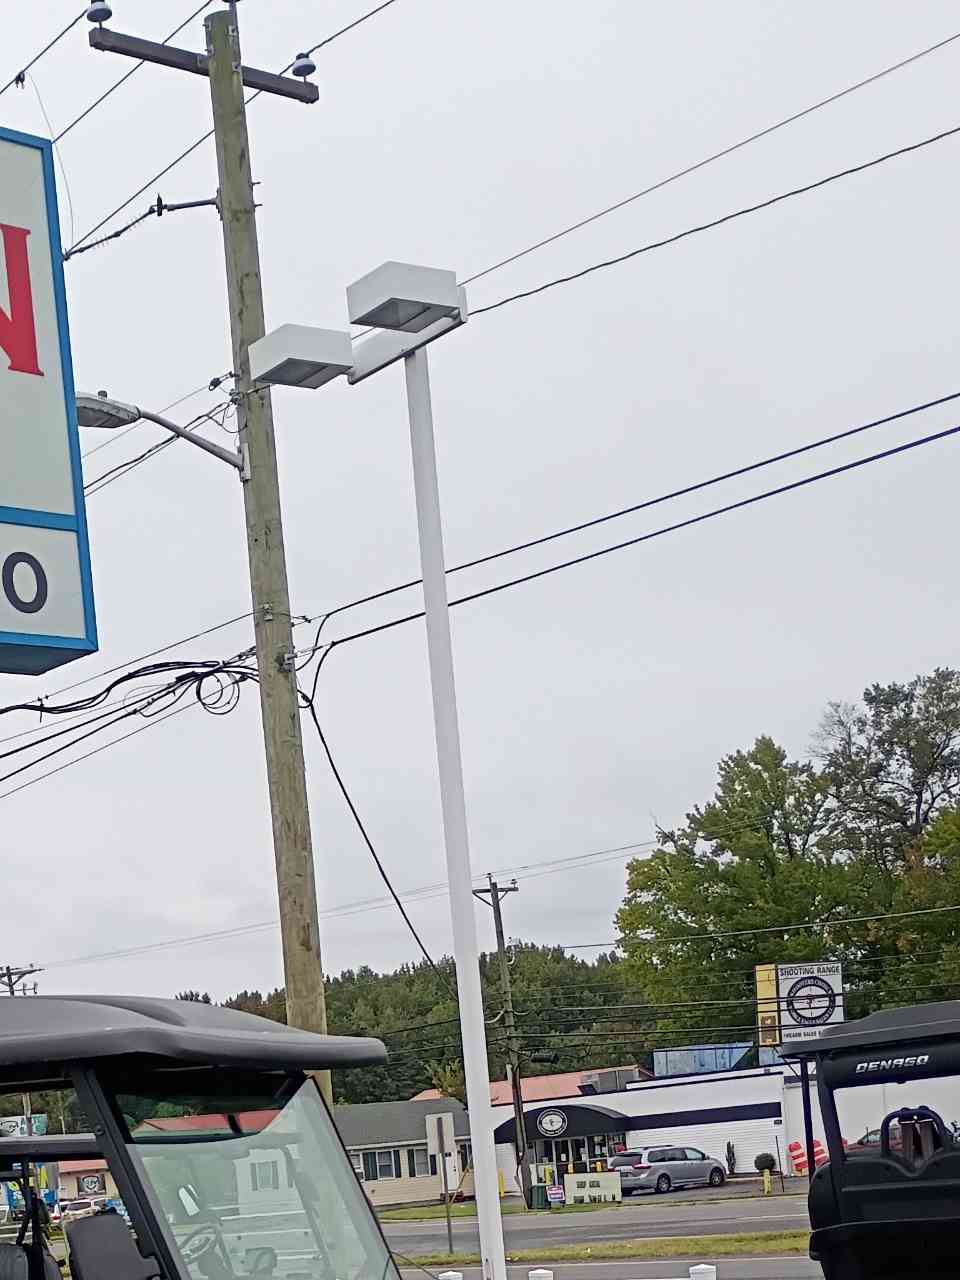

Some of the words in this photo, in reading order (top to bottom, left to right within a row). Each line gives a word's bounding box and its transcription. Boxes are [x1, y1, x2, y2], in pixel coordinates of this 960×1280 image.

[778, 966, 816, 977] SHOOTING
[816, 964, 841, 975] RANGE
[855, 1055, 929, 1074] DENAGO
